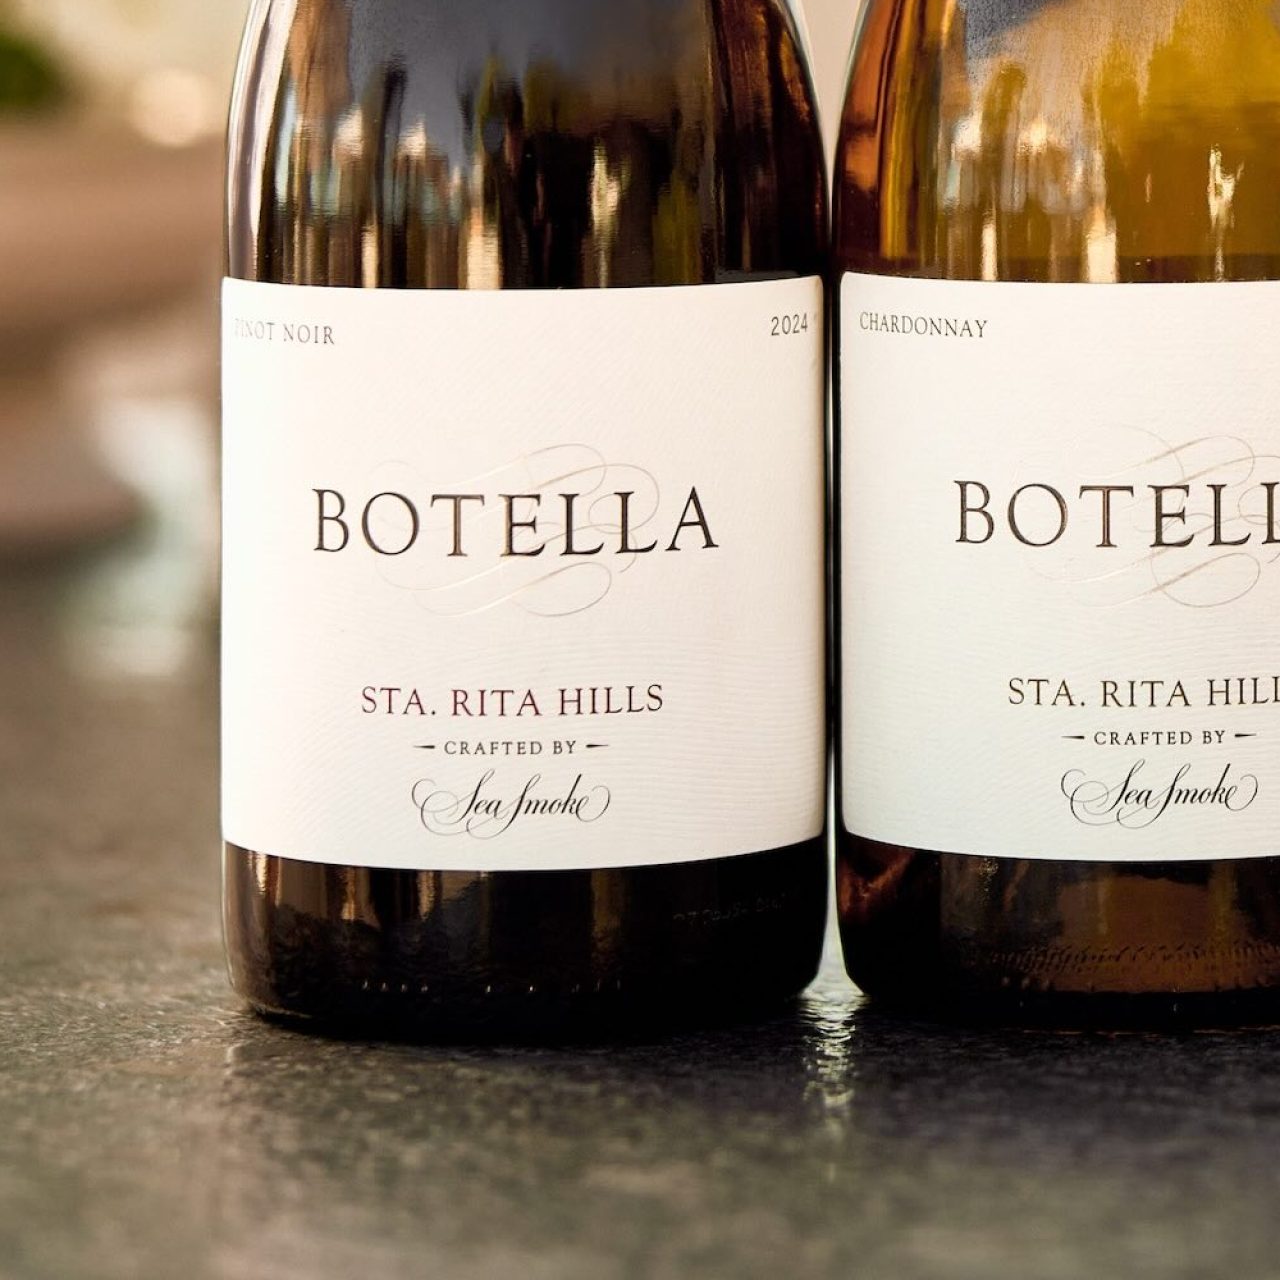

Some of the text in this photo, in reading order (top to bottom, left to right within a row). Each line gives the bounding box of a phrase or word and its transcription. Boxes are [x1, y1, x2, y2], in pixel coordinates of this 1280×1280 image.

[282, 323, 335, 345] NOIR
[771, 312, 808, 336] 2024
[860, 311, 987, 338] CHARDONNAY
[312, 485, 720, 558] BOTELLA
[361, 684, 664, 717] STA. RITA HILLS
[1007, 677, 1086, 708] STA.
[1101, 679, 1193, 708] RITA
[444, 740, 577, 756] CRAFTED BY
[1093, 730, 1226, 746] CRAFTED BY
[466, 773, 611, 840] Smoke
[1116, 763, 1259, 829] Smoke
